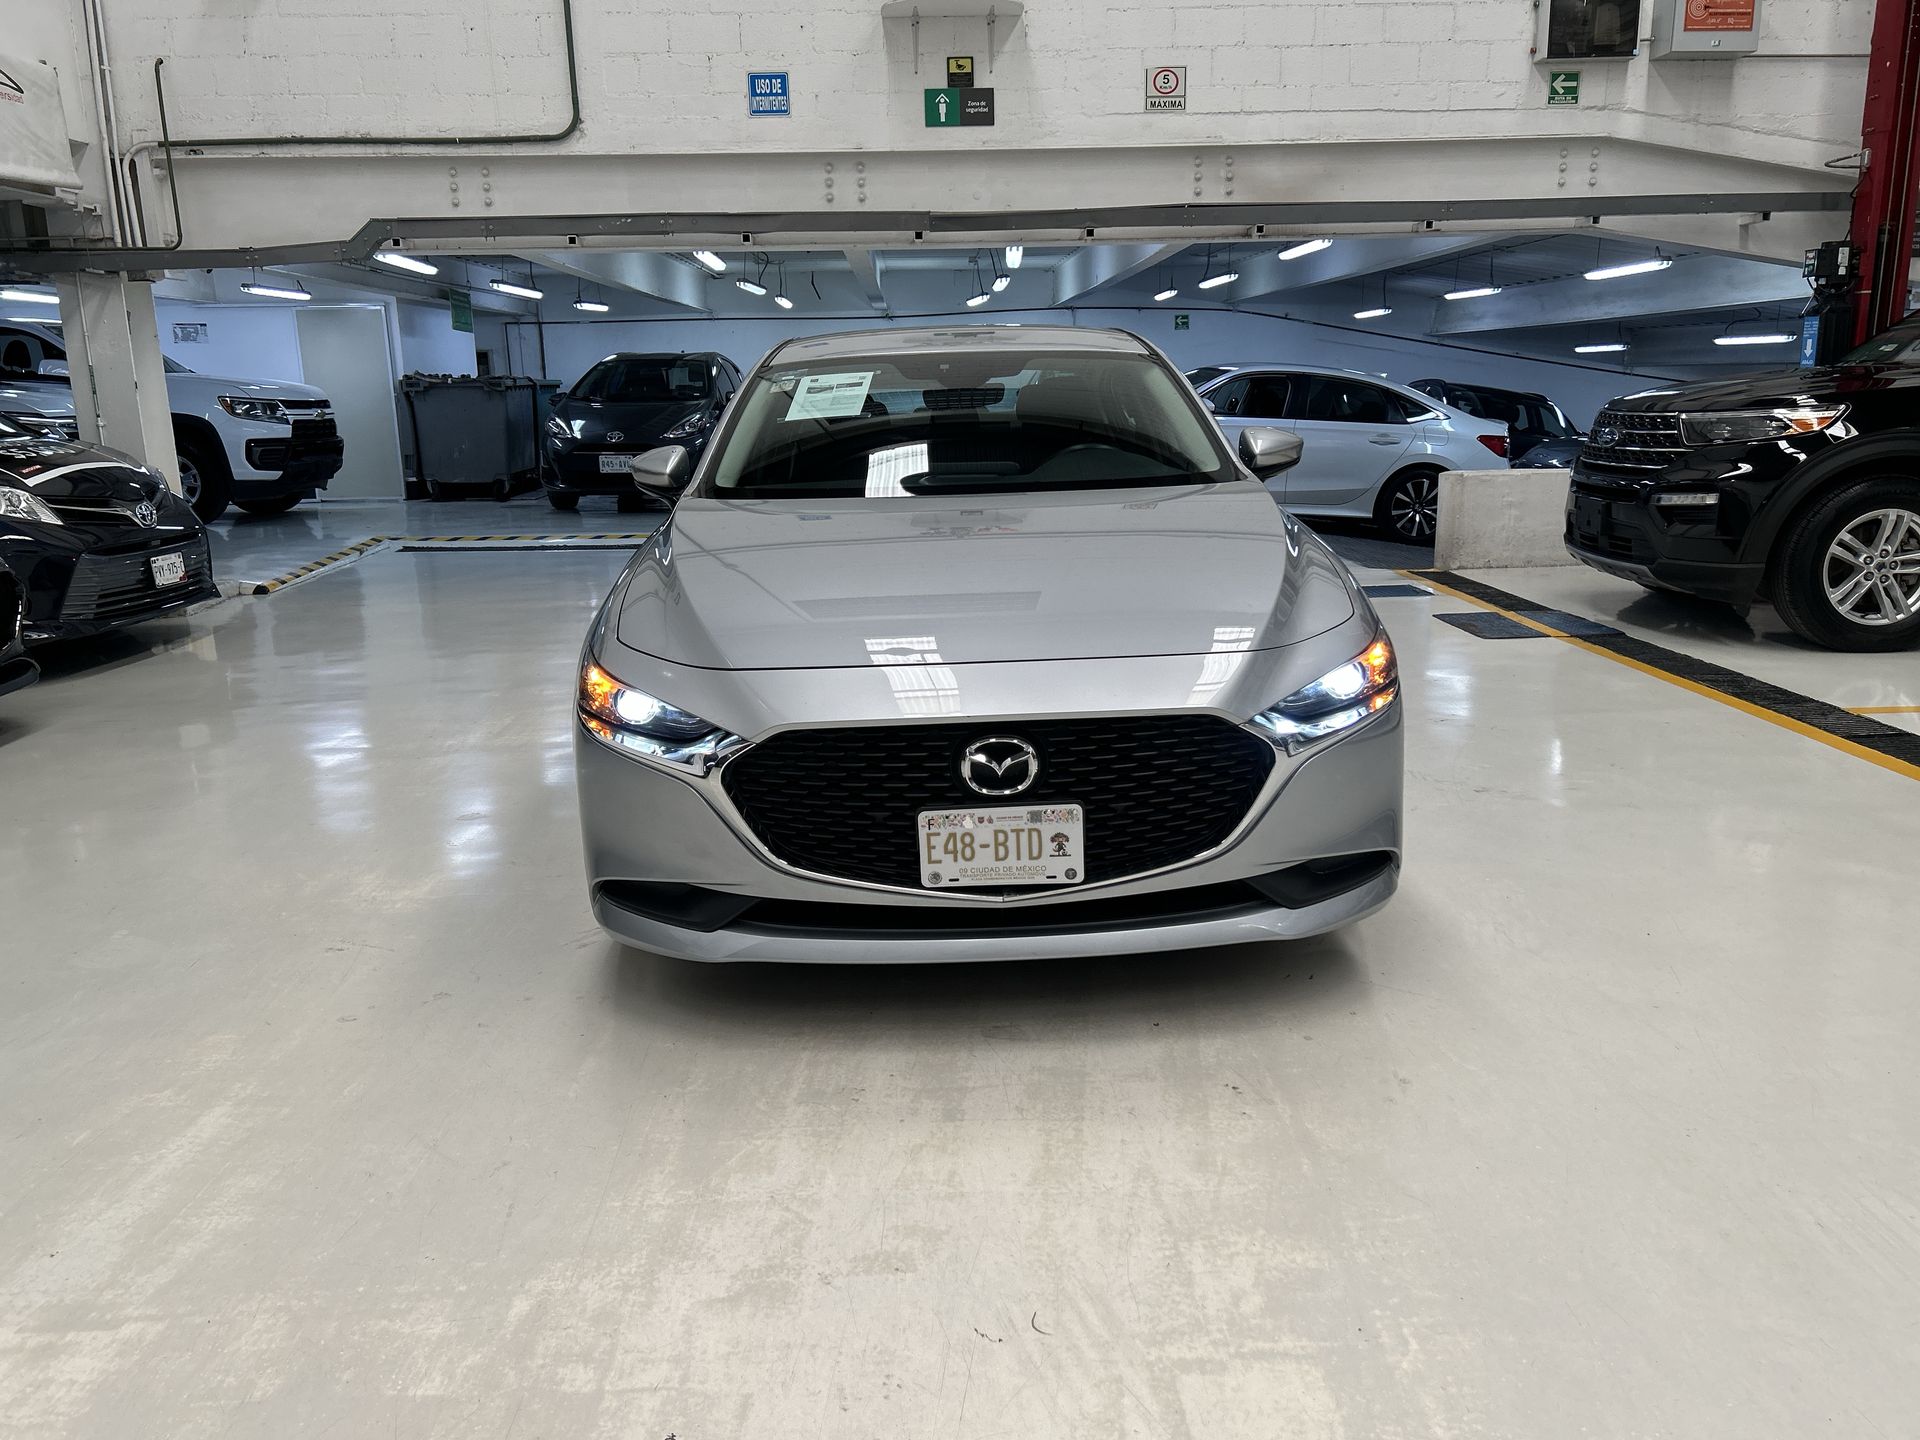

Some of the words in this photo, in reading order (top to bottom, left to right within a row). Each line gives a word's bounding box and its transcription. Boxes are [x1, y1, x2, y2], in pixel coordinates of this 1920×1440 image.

[755, 79, 770, 94] USO
[772, 78, 782, 94] DE
[1162, 74, 1170, 85] 5
[751, 95, 787, 111] INTERMITENTES
[1150, 98, 1183, 109] MÁXIMA
[926, 827, 1043, 865] E48-BTD
[970, 866, 1001, 874] CIUDAD
[1015, 864, 1047, 872] MÉXICO
